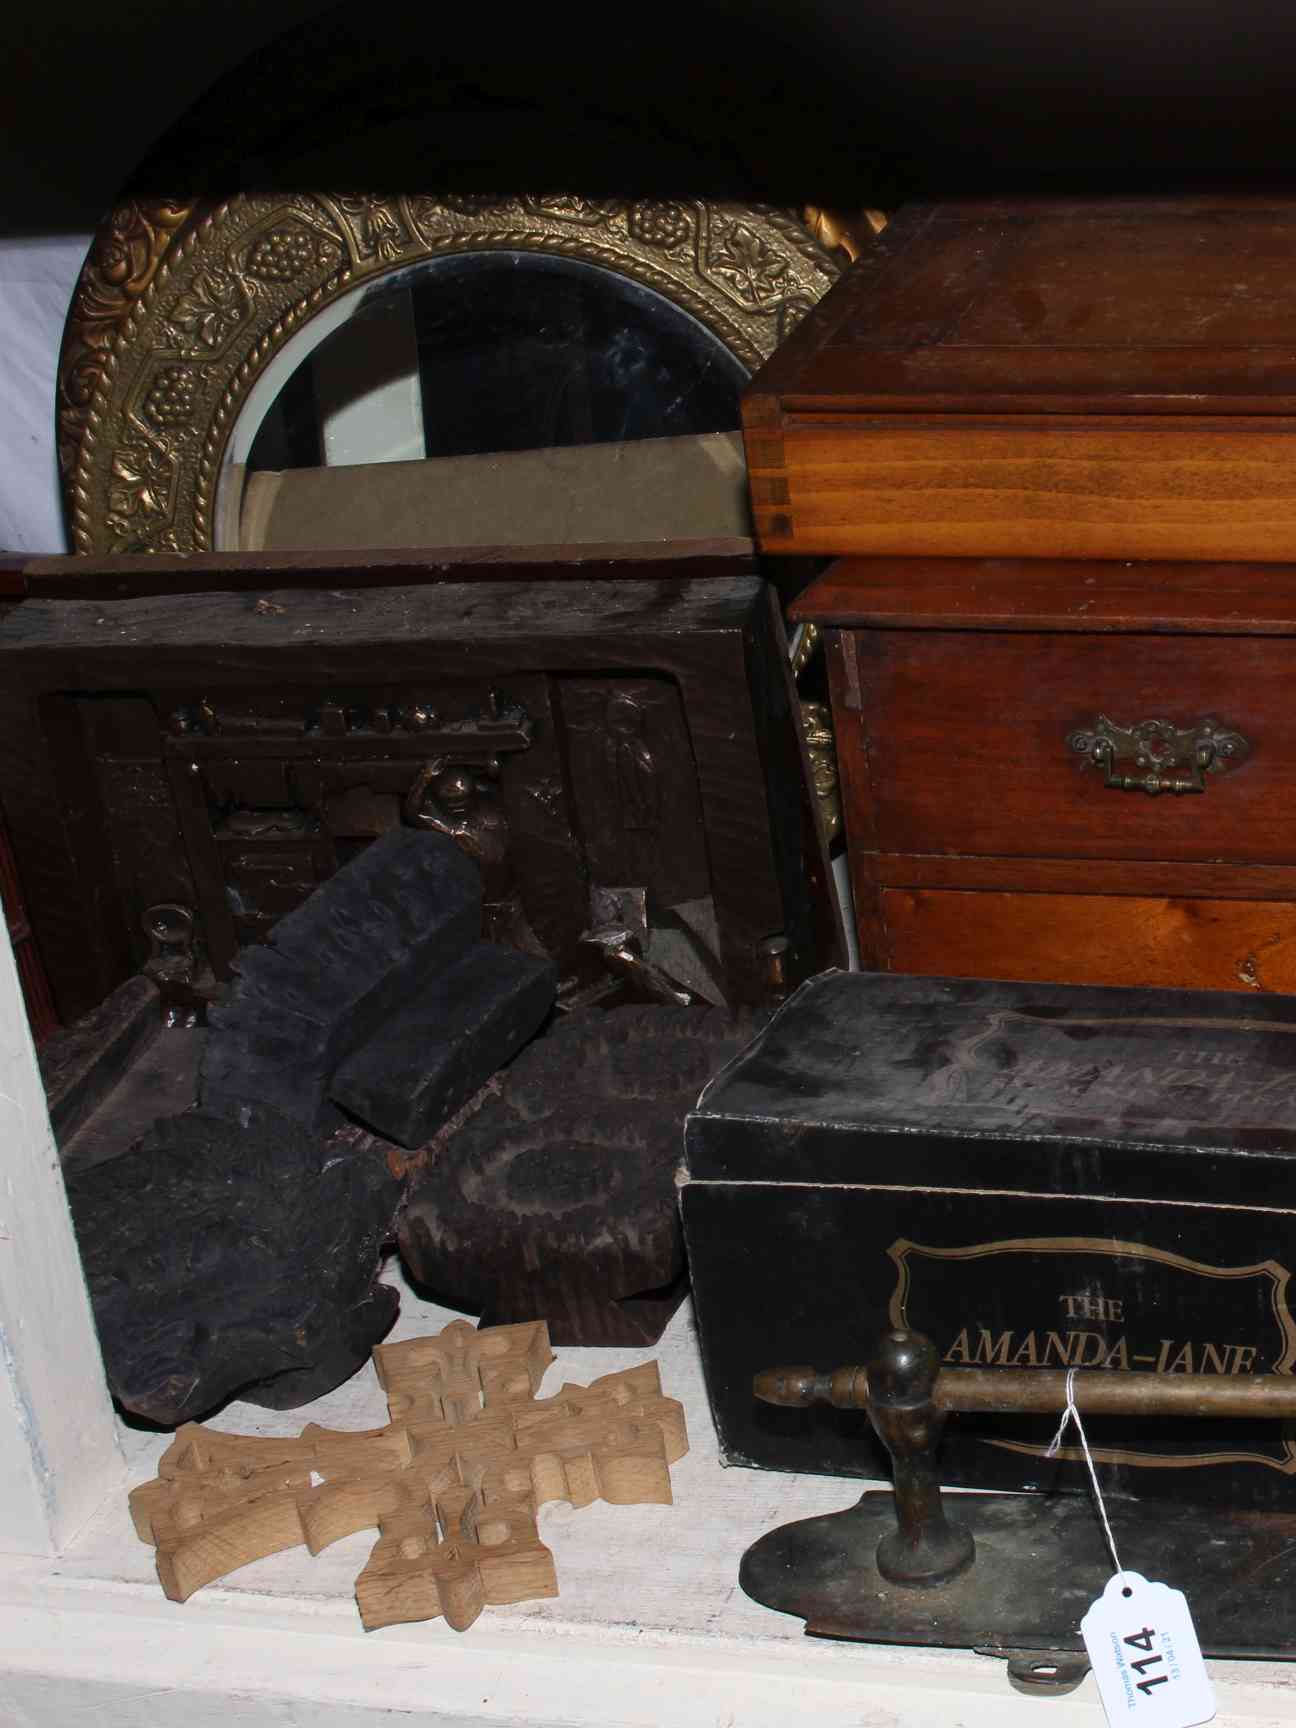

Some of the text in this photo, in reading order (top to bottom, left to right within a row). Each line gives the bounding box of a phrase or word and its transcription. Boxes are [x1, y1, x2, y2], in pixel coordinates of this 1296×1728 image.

[1059, 1295, 1125, 1323] THE
[944, 1327, 1257, 1375] AMANDA-JANE
[1123, 1626, 1169, 1696] 114
